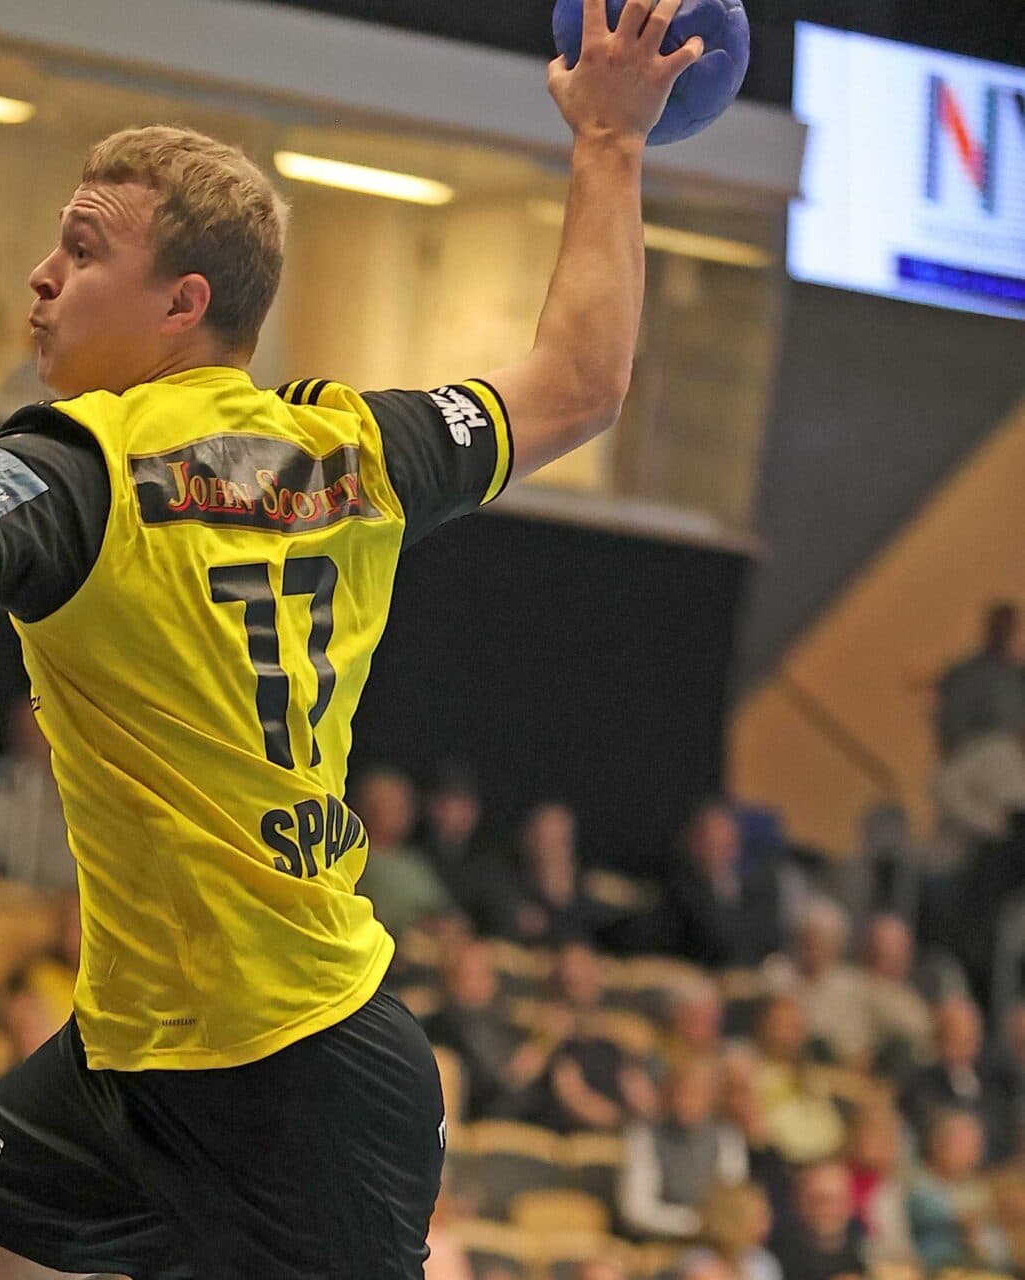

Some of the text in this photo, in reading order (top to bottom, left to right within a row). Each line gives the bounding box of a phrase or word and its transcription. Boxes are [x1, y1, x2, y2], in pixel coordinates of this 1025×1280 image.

[166, 461, 360, 524] JOHN SCOTT
[208, 555, 339, 770] 17
[260, 793, 367, 879] SPAN
